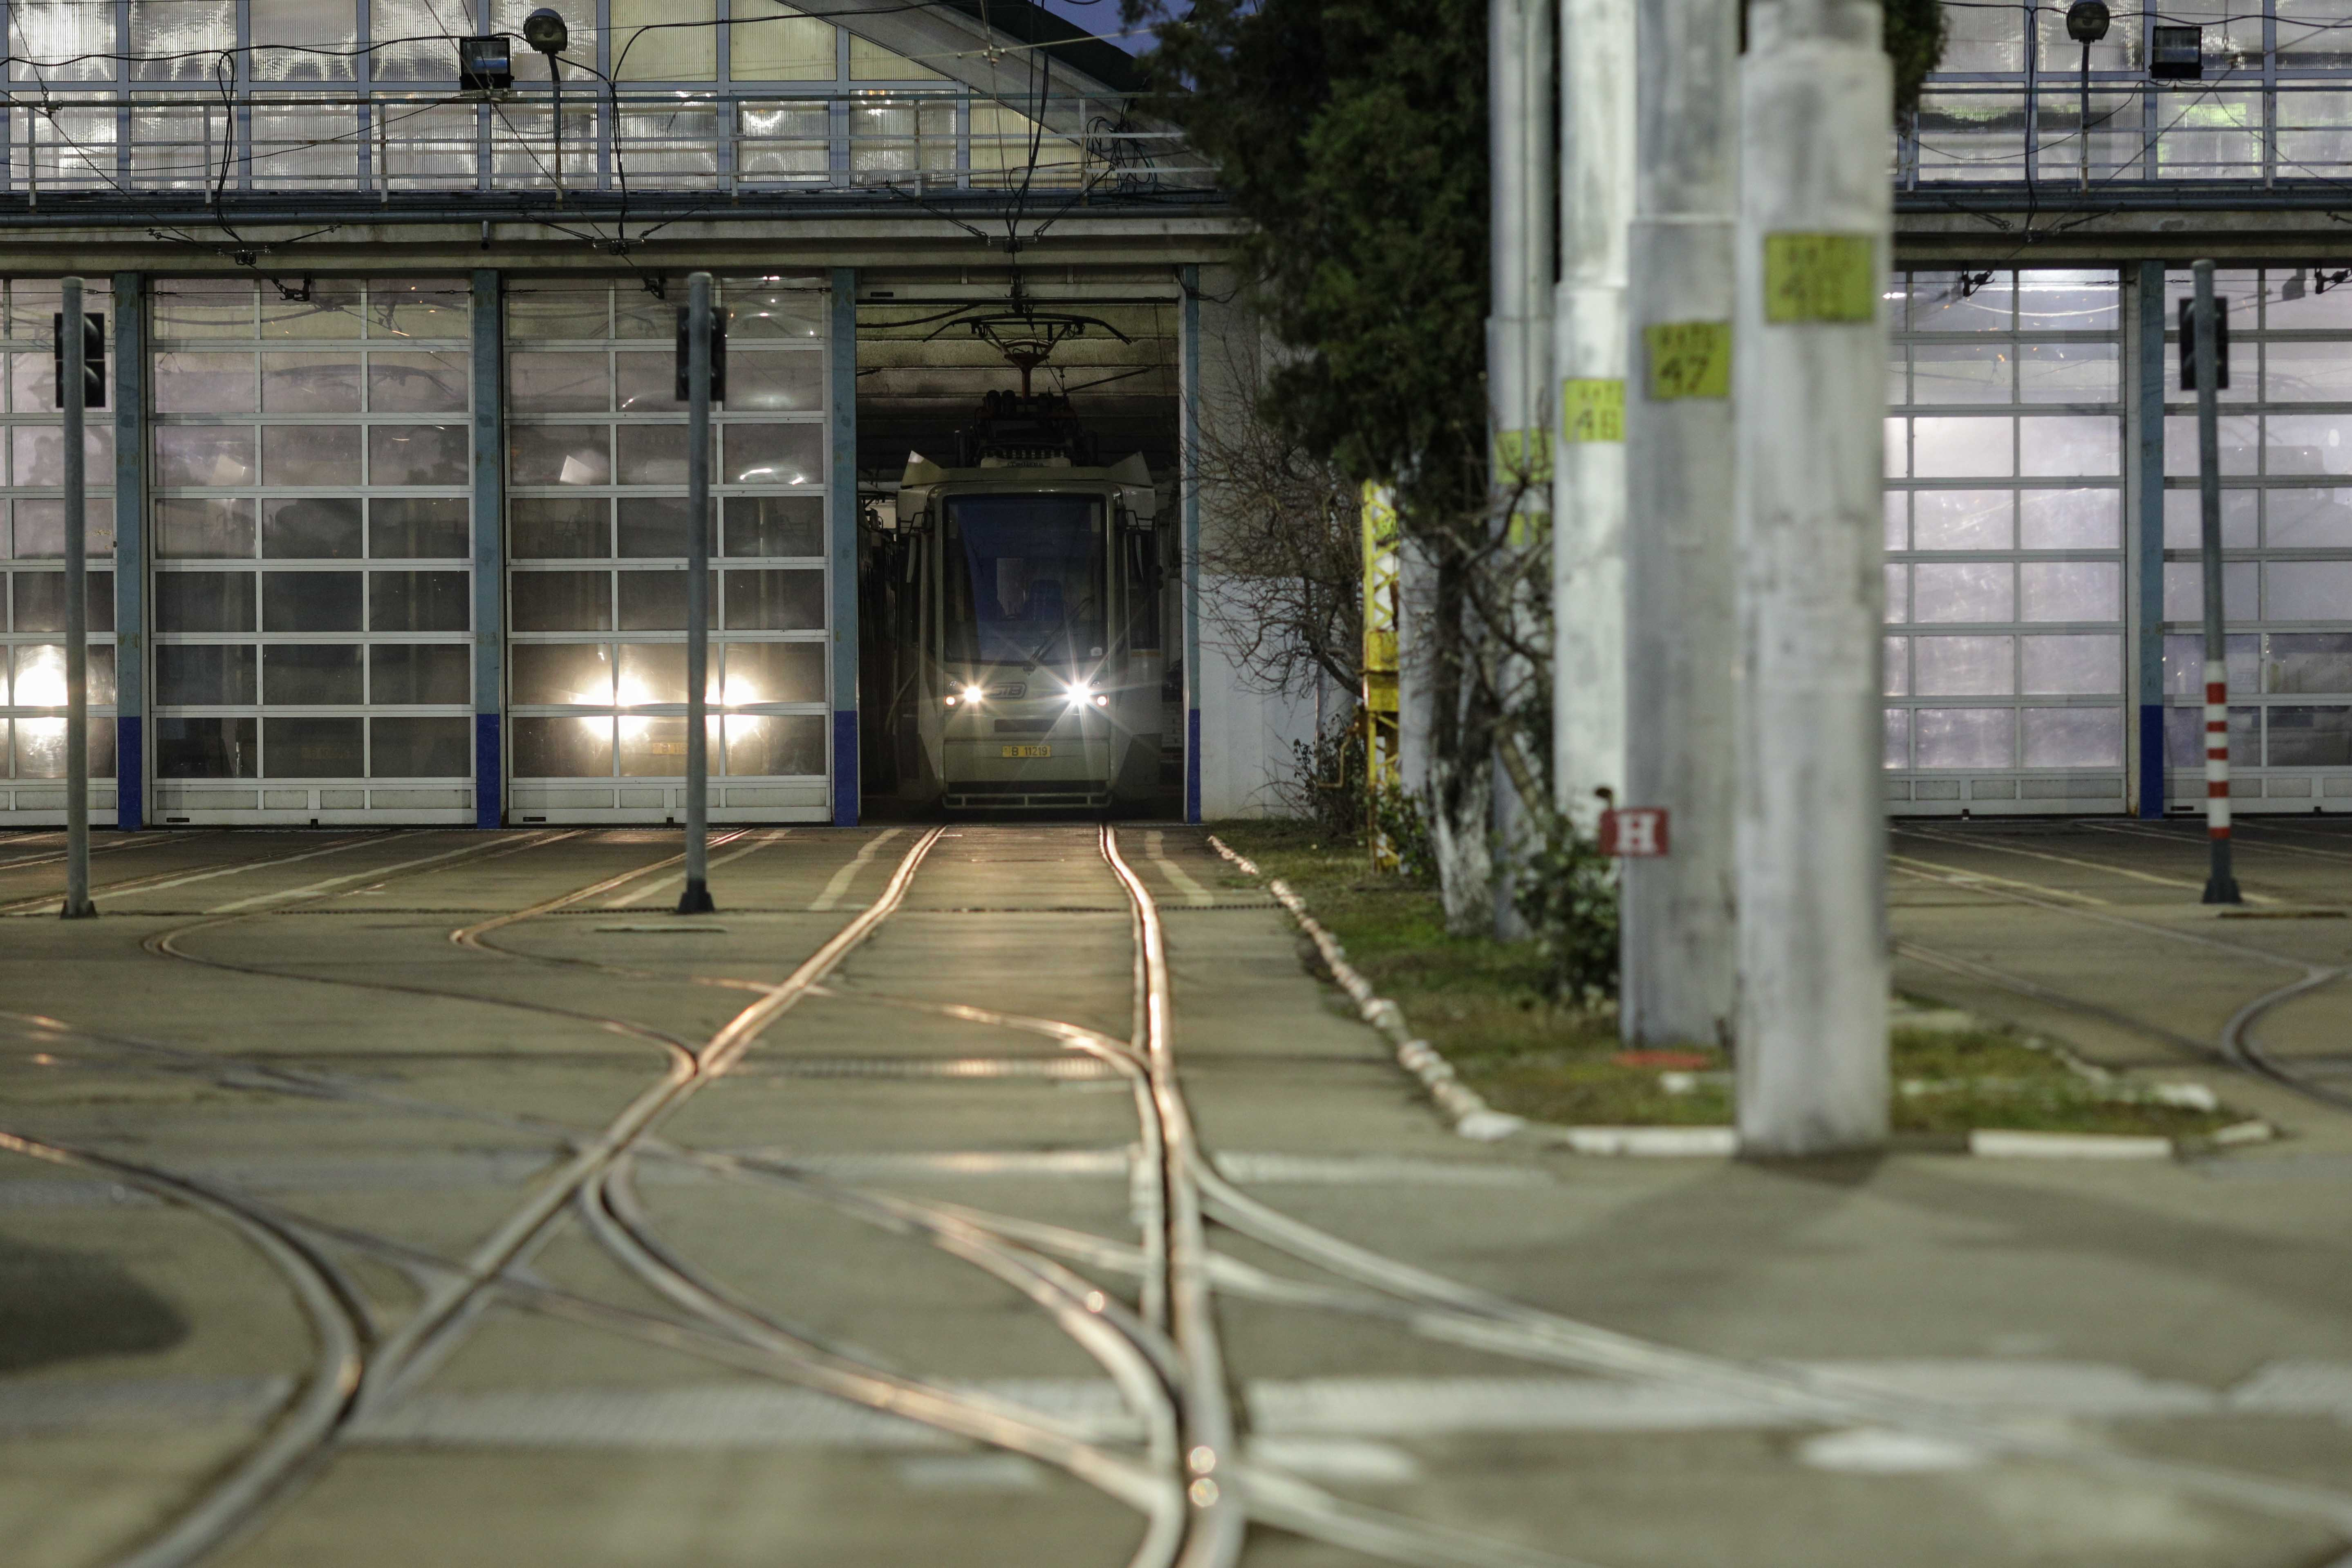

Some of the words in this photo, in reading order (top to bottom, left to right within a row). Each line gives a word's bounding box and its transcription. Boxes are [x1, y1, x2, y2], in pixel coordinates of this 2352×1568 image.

[1660, 356, 1709, 392] 47
[1012, 747, 1018, 756] B
[1025, 747, 1047, 755] 11219
